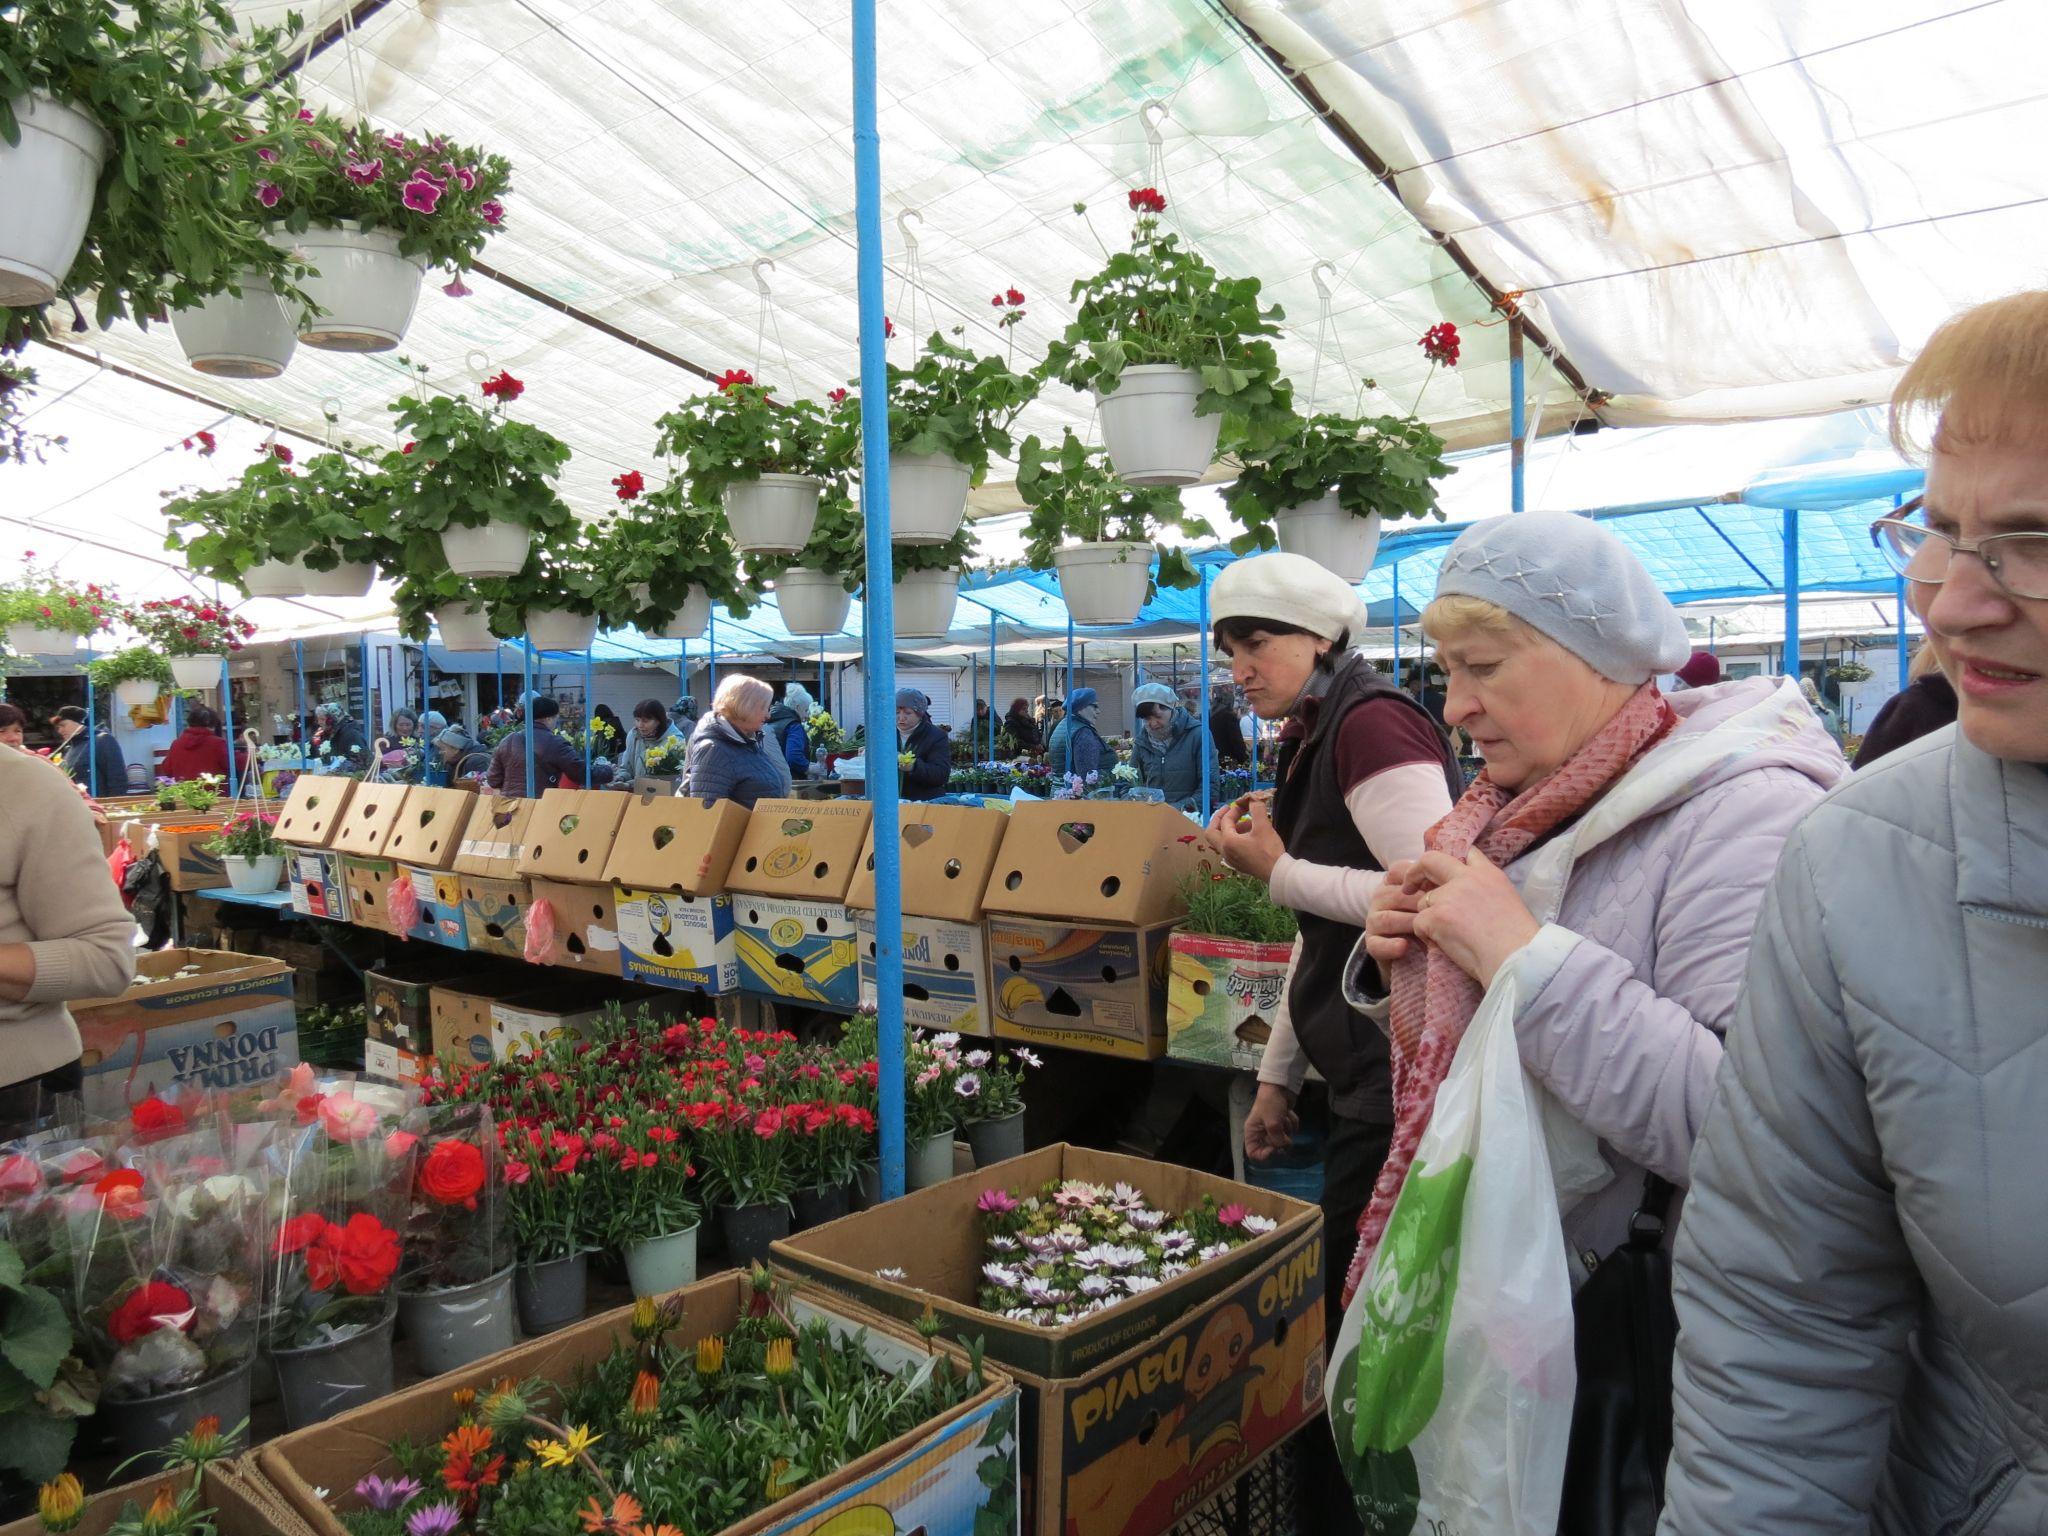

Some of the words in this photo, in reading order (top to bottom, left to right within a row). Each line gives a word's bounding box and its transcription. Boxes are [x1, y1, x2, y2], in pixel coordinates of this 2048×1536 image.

[766, 902, 801, 916] PREMIUM
[802, 906, 843, 919] SELECTED
[674, 913, 698, 922] ECUADOR
[902, 936, 931, 963] BONI
[628, 961, 666, 977] BANANAS
[667, 968, 710, 985] PREMIUM
[221, 985, 237, 996] OF
[239, 974, 285, 992] PRODUCT
[165, 988, 219, 1006] ECUADOR
[911, 1009, 952, 1025] PREMIUM
[1020, 1025, 1060, 1041] Ecuador
[1061, 1032, 1072, 1041] of
[1074, 1031, 1116, 1048] Product
[166, 1026, 279, 1076] DONNA
[1172, 1446, 1250, 1515] PREMIUM
